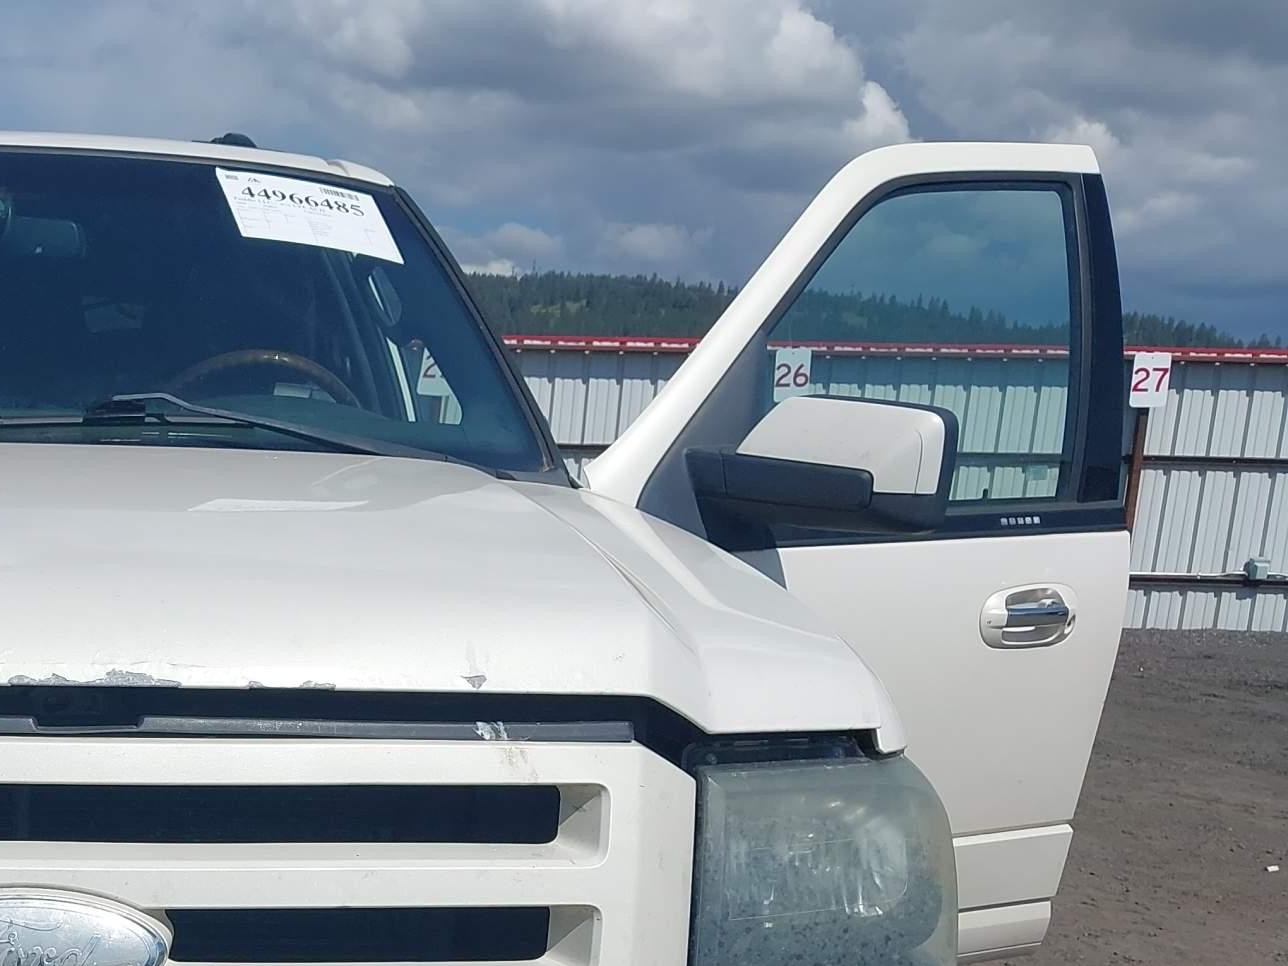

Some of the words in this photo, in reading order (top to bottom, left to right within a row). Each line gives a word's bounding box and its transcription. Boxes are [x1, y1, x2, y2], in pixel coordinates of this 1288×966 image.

[241, 186, 365, 217] 44966485
[774, 363, 809, 388] 26
[1131, 367, 1170, 393] 27
